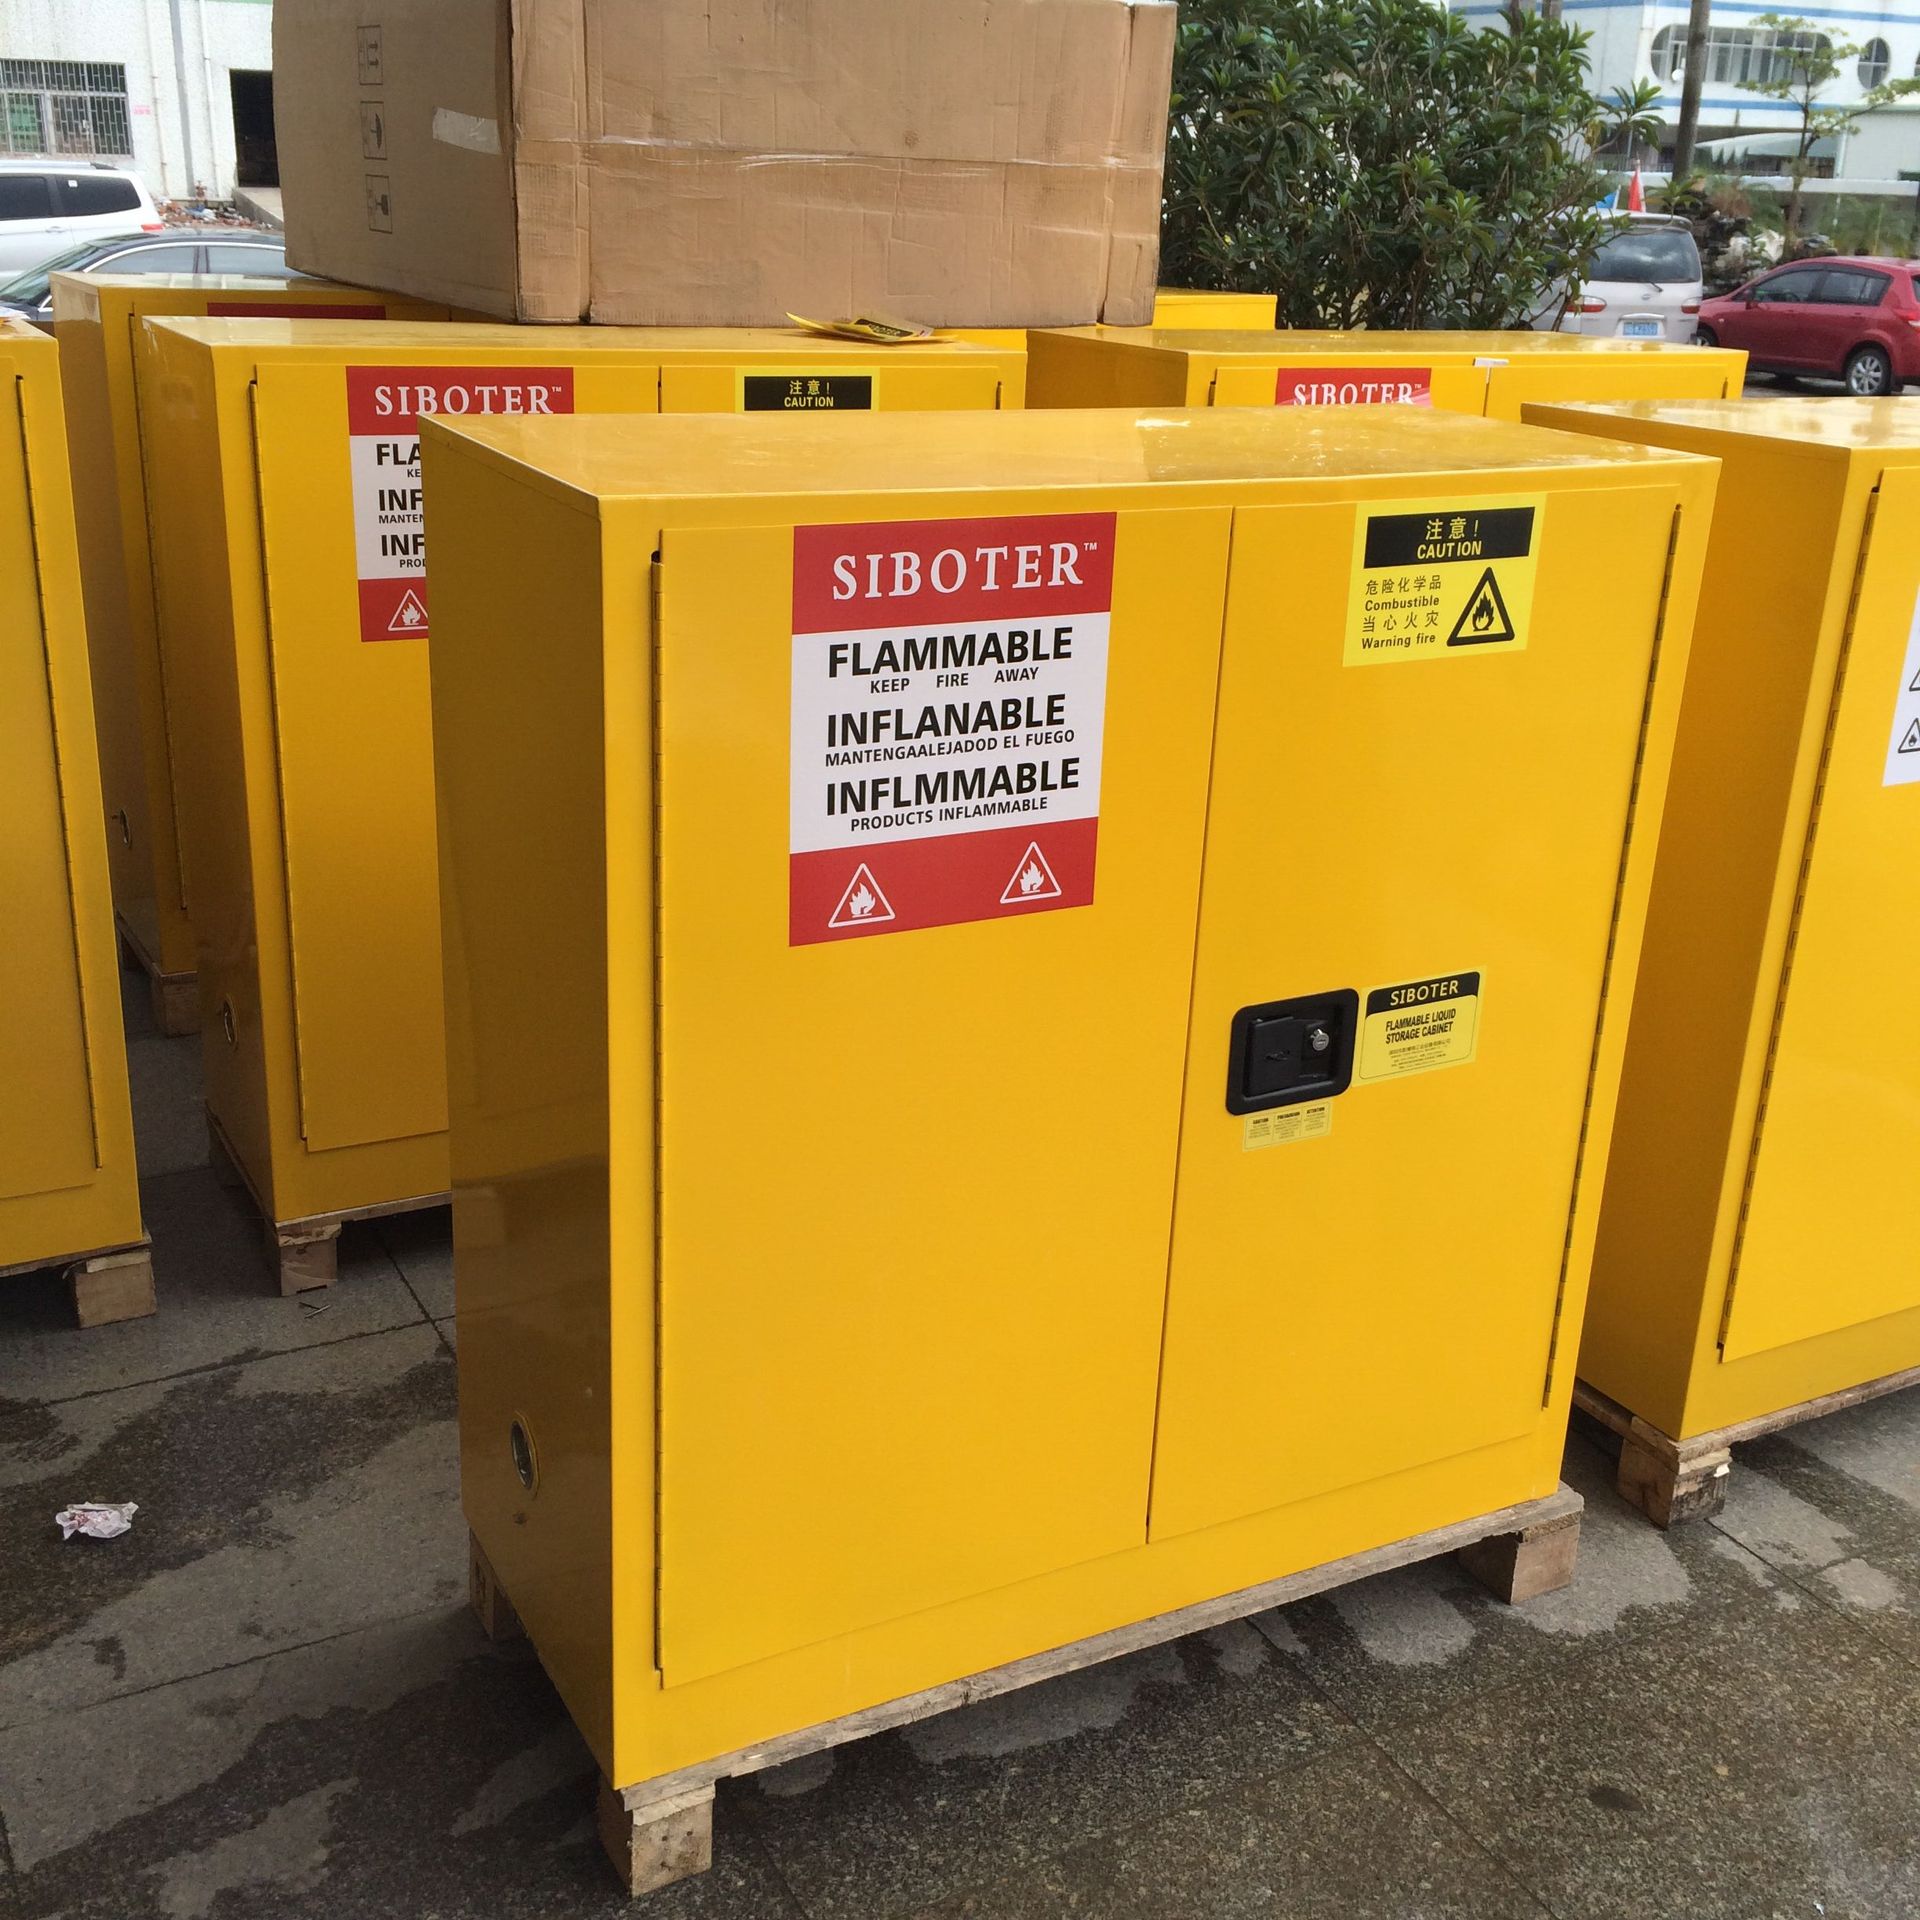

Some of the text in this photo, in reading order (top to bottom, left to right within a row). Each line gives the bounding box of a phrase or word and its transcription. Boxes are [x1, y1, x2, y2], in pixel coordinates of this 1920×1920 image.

[784, 396, 834, 408] CAUTION
[1417, 540, 1483, 560] CAUTION
[1365, 574, 1442, 596] 危险化学品
[1364, 595, 1441, 612] Combustible
[1361, 610, 1440, 633] 当心火灾
[829, 626, 1073, 679] FLAMMABLE
[1361, 632, 1436, 650] Warning fire
[869, 666, 1040, 694] KEEP FIRE AWAY
[827, 693, 1067, 748] INFLANABLE
[825, 729, 1076, 767] MANTENGAALEJADOD EL FUEGO
[826, 757, 1081, 817] INFLMMABLE
[850, 796, 1049, 832] PRODUCTS INFLAMMABLE
[1389, 979, 1459, 1006] SIBOTER
[1385, 1008, 1457, 1033] FLAMMABLE LIQUID
[1385, 1021, 1454, 1045] STORAGE CABINET
